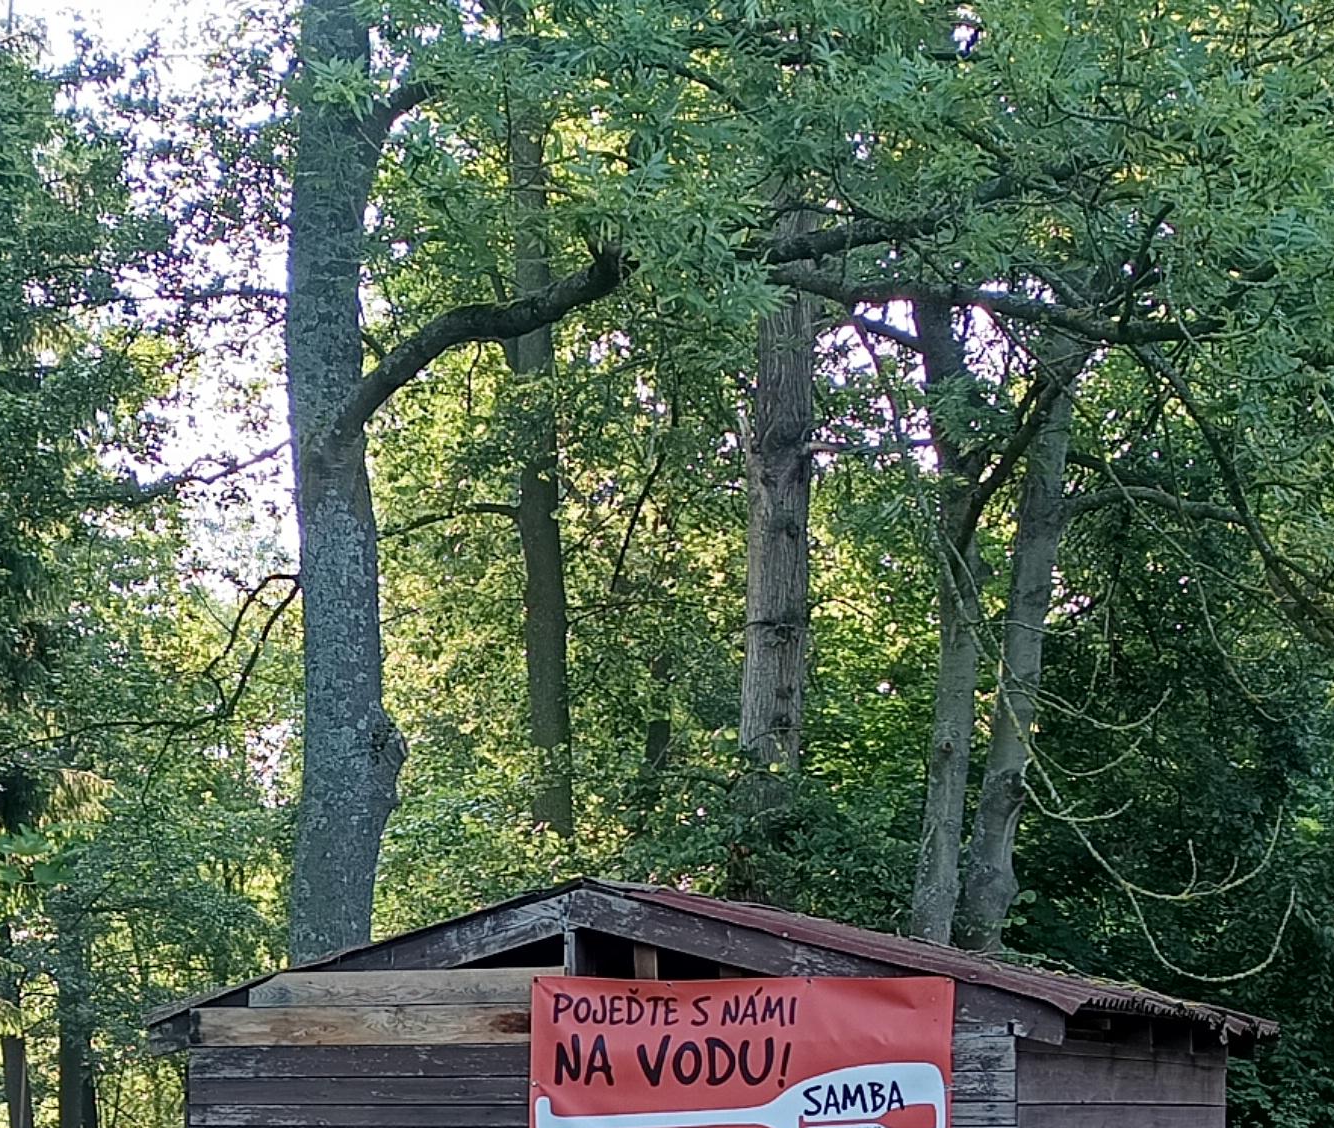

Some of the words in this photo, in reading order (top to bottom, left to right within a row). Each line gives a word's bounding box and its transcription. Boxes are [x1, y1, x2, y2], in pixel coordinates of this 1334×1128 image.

[553, 988, 681, 1026] POJEĎTE
[690, 995, 711, 1026] S
[720, 986, 797, 1027] NÁMI
[554, 1033, 614, 1086] NA
[636, 1034, 791, 1088] VODU!
[803, 1080, 905, 1116] SAMBA
